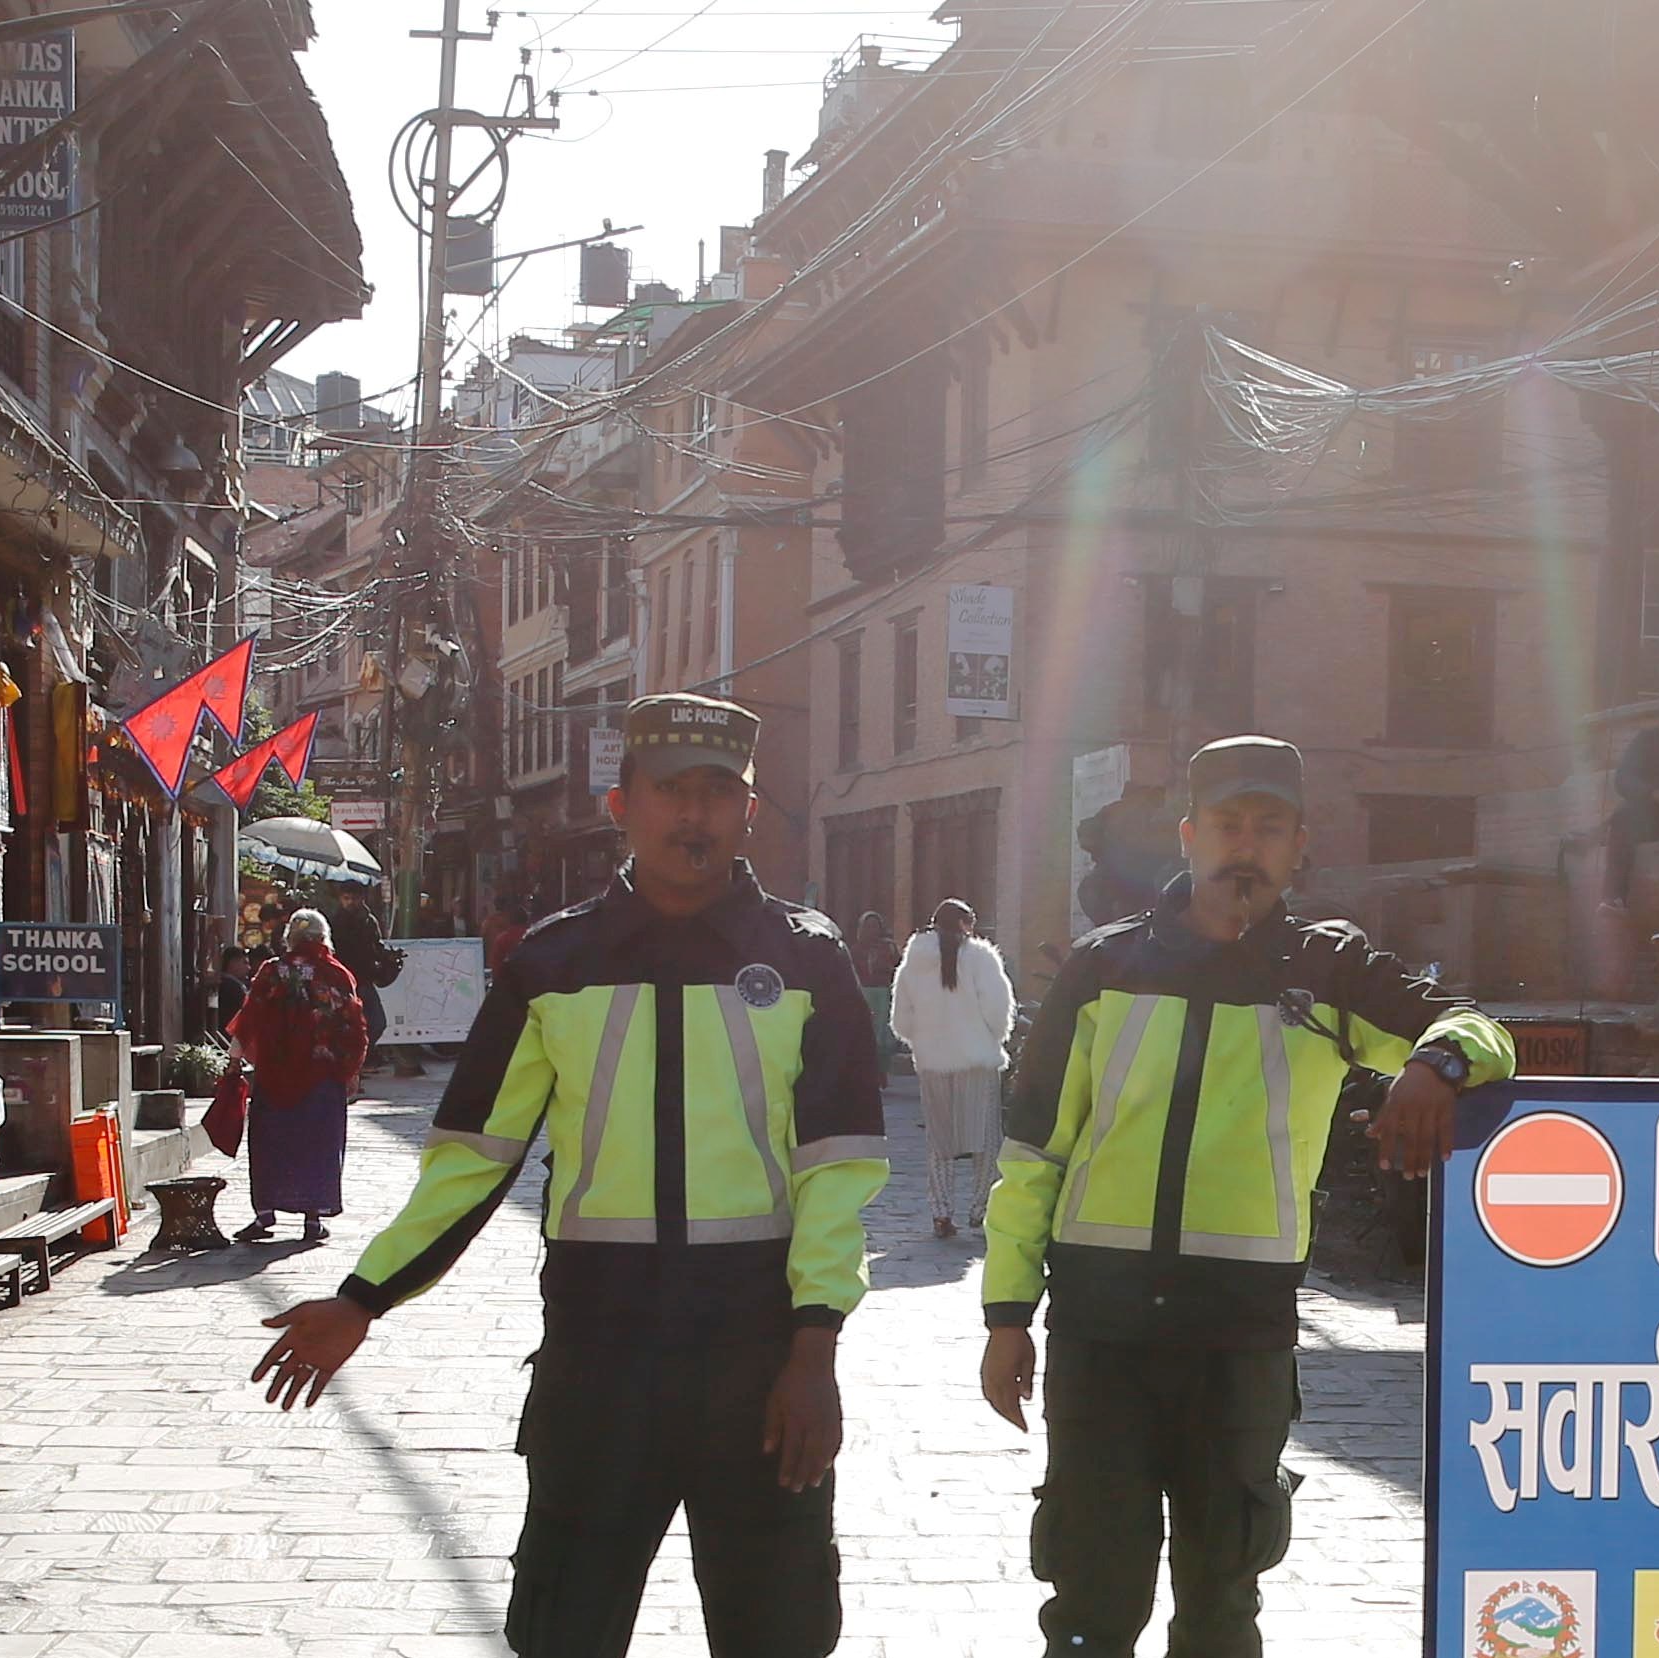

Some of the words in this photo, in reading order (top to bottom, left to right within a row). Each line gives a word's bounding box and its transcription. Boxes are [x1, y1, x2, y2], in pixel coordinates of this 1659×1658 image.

[695, 708, 730, 726] POLICE
[7, 929, 104, 949] THANKA
[2, 953, 106, 974] SCHOOL
